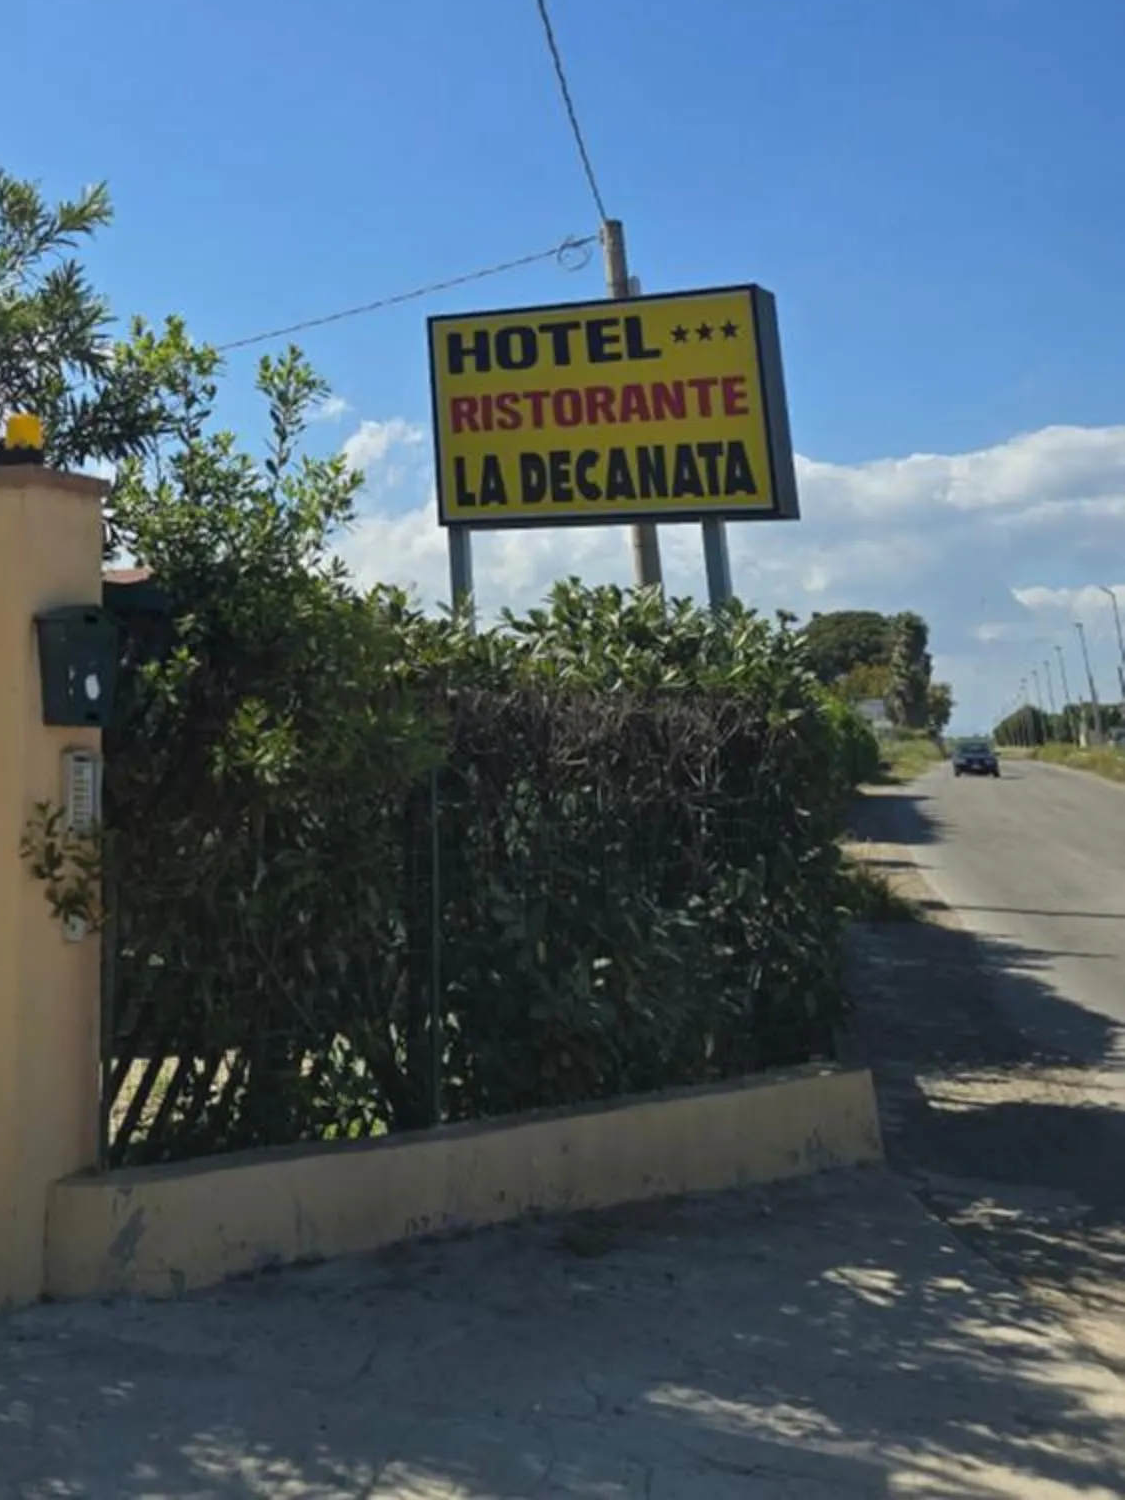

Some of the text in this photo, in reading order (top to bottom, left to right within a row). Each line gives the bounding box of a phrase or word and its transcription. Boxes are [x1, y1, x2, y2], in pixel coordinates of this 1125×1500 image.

[446, 316, 662, 375] HOTEL
[450, 376, 750, 434] RISTORANTE
[454, 440, 757, 507] LA DECANATA
